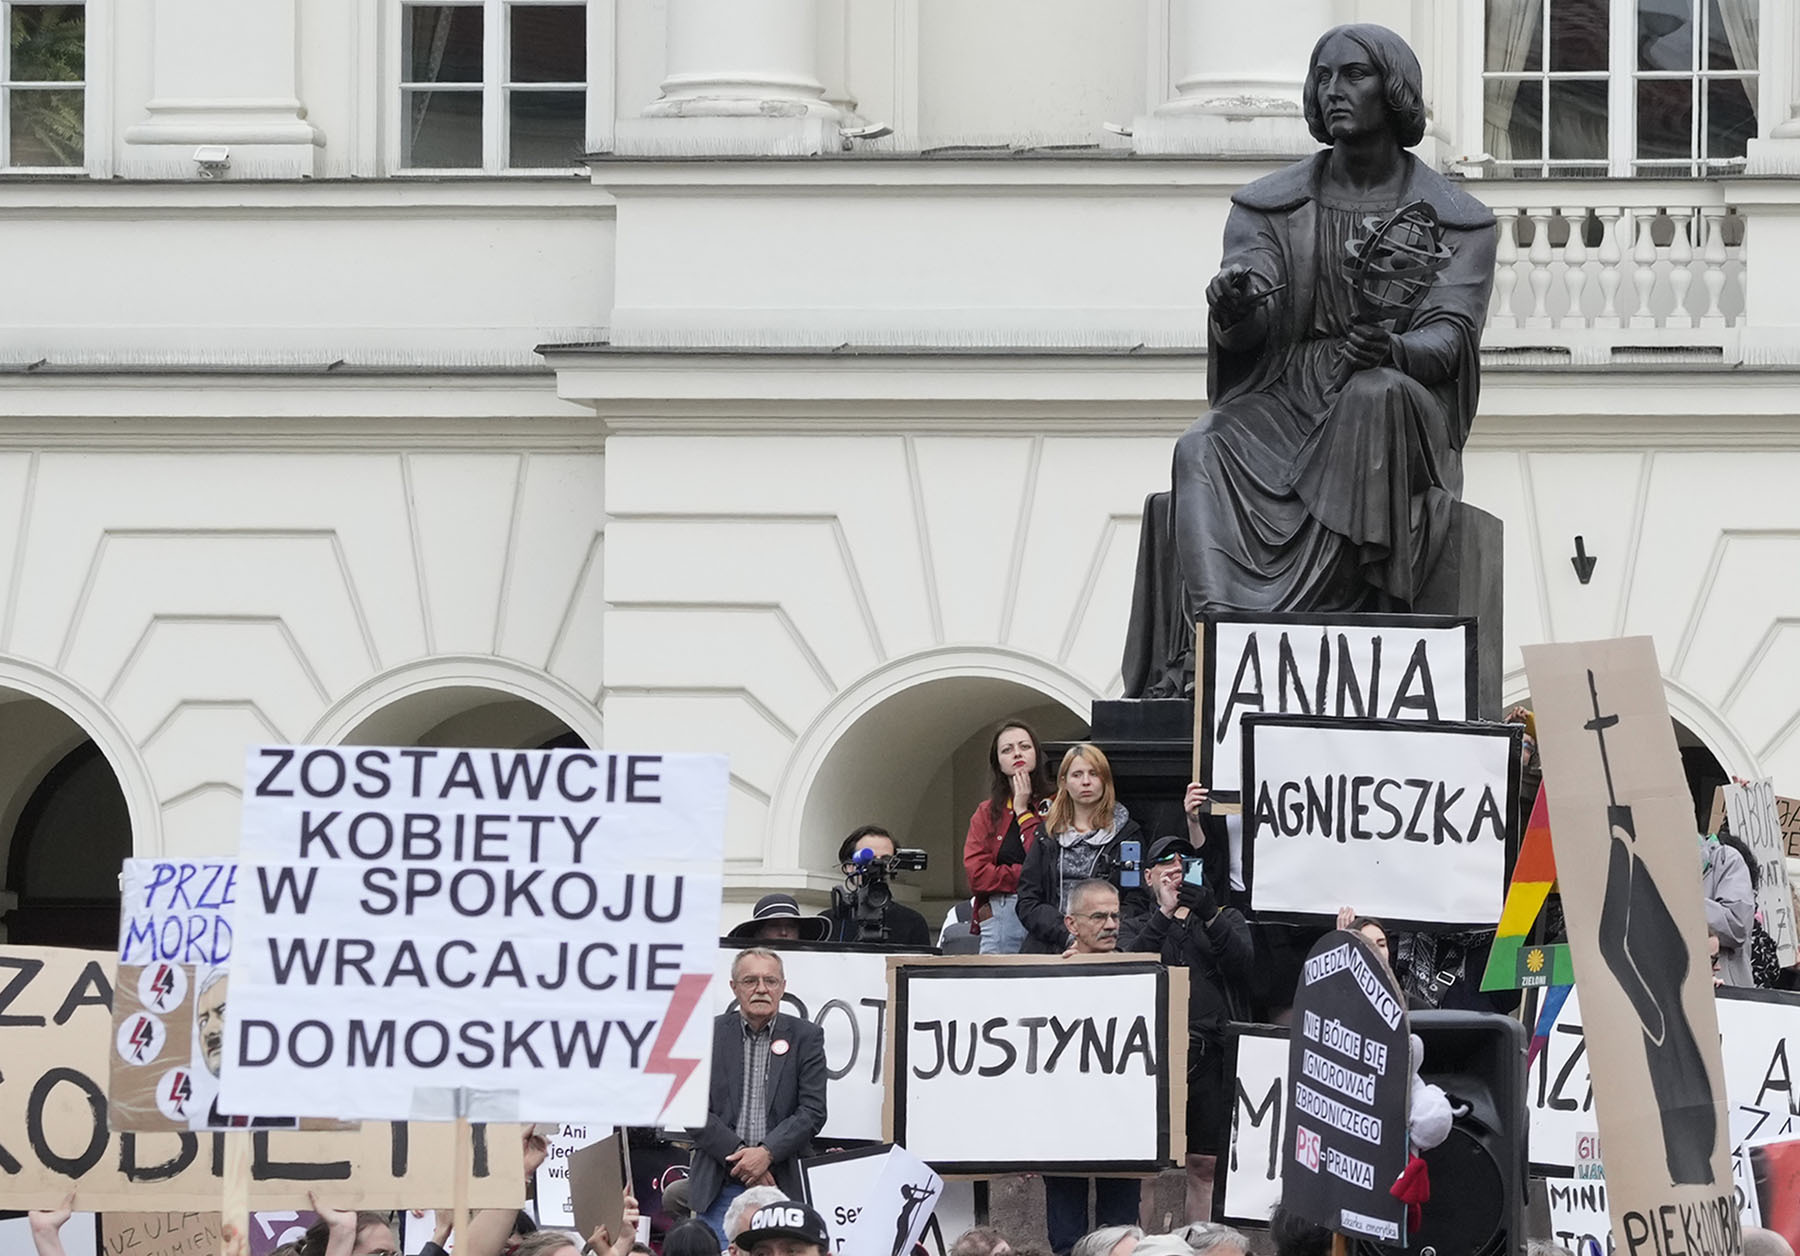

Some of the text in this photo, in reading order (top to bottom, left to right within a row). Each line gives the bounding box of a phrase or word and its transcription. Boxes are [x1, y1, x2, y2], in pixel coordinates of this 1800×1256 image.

[1217, 627, 1439, 744] ANNA
[255, 748, 664, 804] ZOSTAWCIE
[299, 811, 600, 864] KOBIETY
[1254, 774, 1507, 846] AGNIESZKA
[257, 867, 684, 924] W SPOKOJU
[267, 937, 685, 991] WRACAJCIE
[1305, 945, 1401, 1025] KOLEDZY MEDYCY
[1521, 975, 1547, 987] ZIELONI
[912, 1015, 1158, 1080] JUSTYNA
[1304, 1012, 1386, 1073] NIE BÓJCIE SIĘ
[1303, 1050, 1375, 1103] IGNOROWAĆ
[562, 1125, 587, 1139] Ani
[1296, 1084, 1381, 1141] ZBRODNICZEGO
[751, 1207, 805, 1230] OMG
